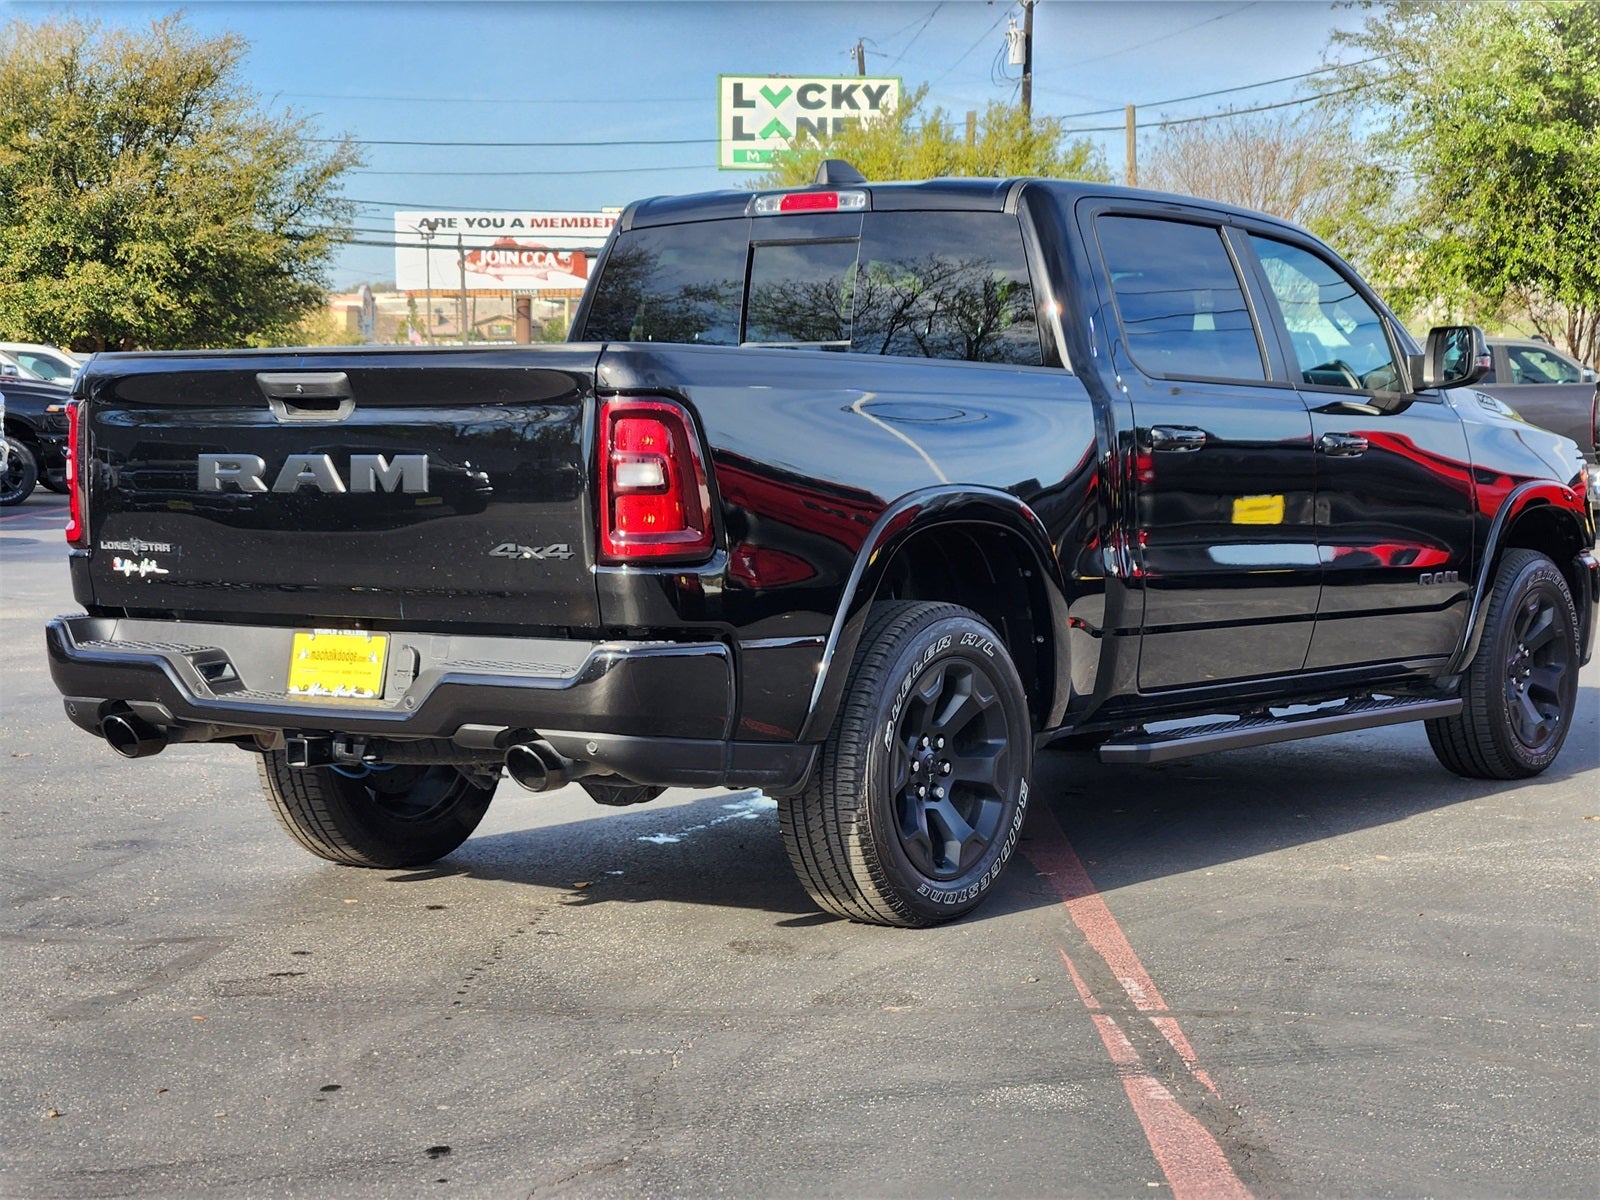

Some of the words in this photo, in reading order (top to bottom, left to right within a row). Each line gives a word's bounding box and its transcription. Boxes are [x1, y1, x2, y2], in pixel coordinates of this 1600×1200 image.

[418, 217, 458, 229] ARE
[464, 217, 505, 229] YOU
[510, 217, 525, 229] A
[530, 217, 617, 229] MEMBER
[477, 250, 521, 267] JOIN
[521, 250, 558, 266] CCA
[197, 453, 429, 493] RAM
[100, 540, 130, 551] LONE
[140, 542, 171, 553] STAR
[1419, 570, 1459, 585] RAM
[916, 776, 1029, 905] BRIDGESTONE
